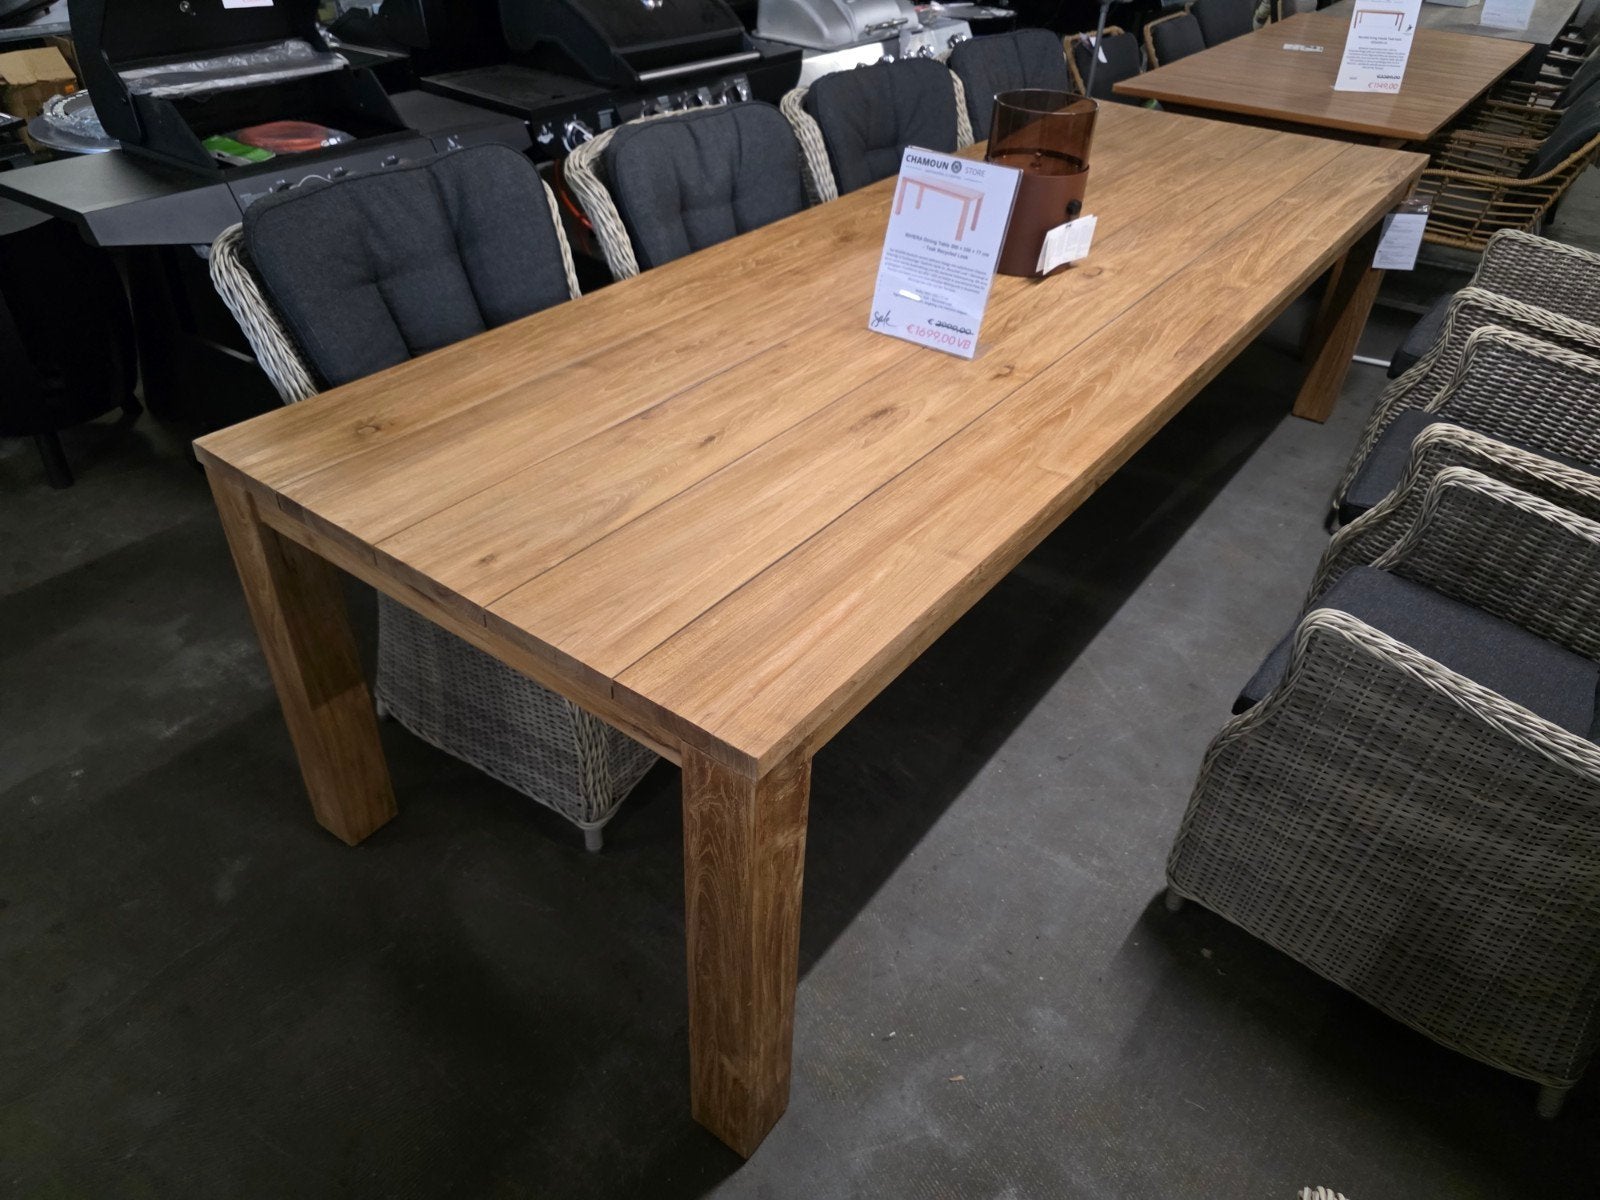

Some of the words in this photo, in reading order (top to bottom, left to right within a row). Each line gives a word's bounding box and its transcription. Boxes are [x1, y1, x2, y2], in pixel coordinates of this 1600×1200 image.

[905, 154, 950, 171] CHAMOUN
[964, 166, 987, 178] STORE
[957, 338, 971, 350] VB
